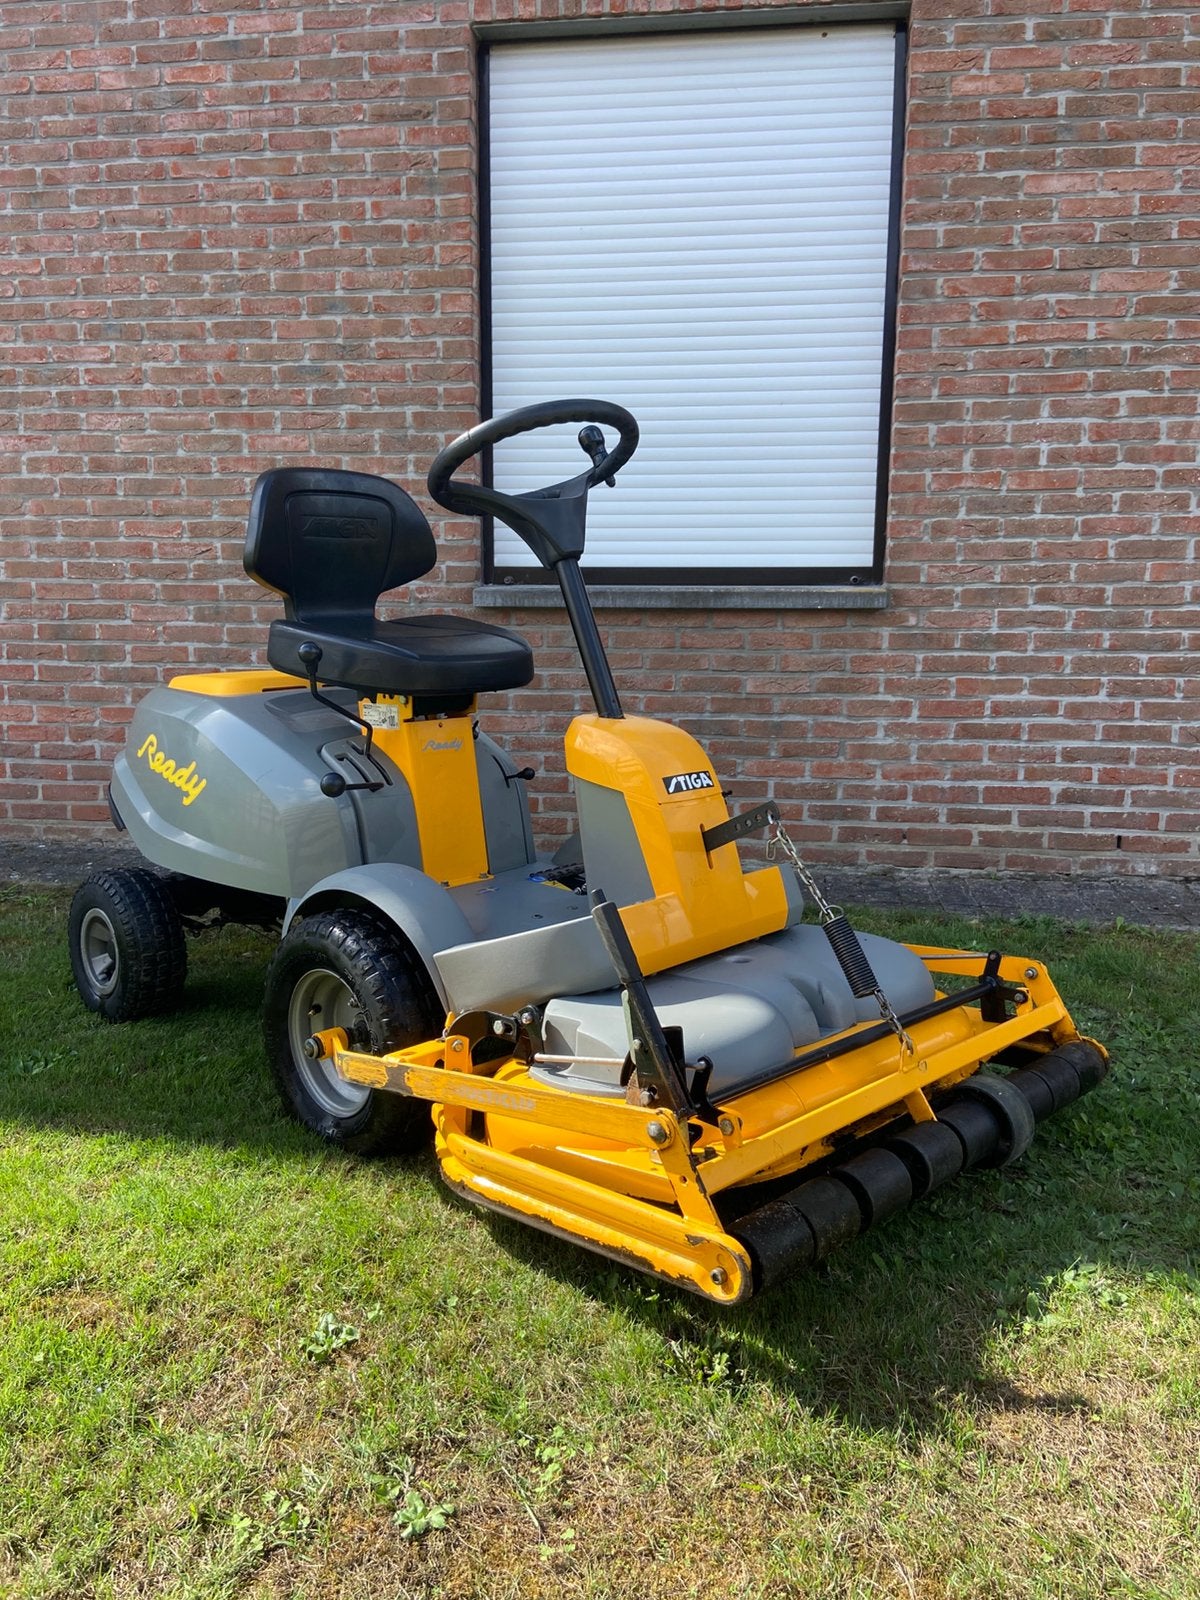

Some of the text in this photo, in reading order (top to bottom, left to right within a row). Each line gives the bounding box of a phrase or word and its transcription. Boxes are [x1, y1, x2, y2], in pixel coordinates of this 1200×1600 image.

[422, 737, 463, 752] Ready
[137, 733, 207, 806] Ready
[668, 772, 713, 793] STIGA
